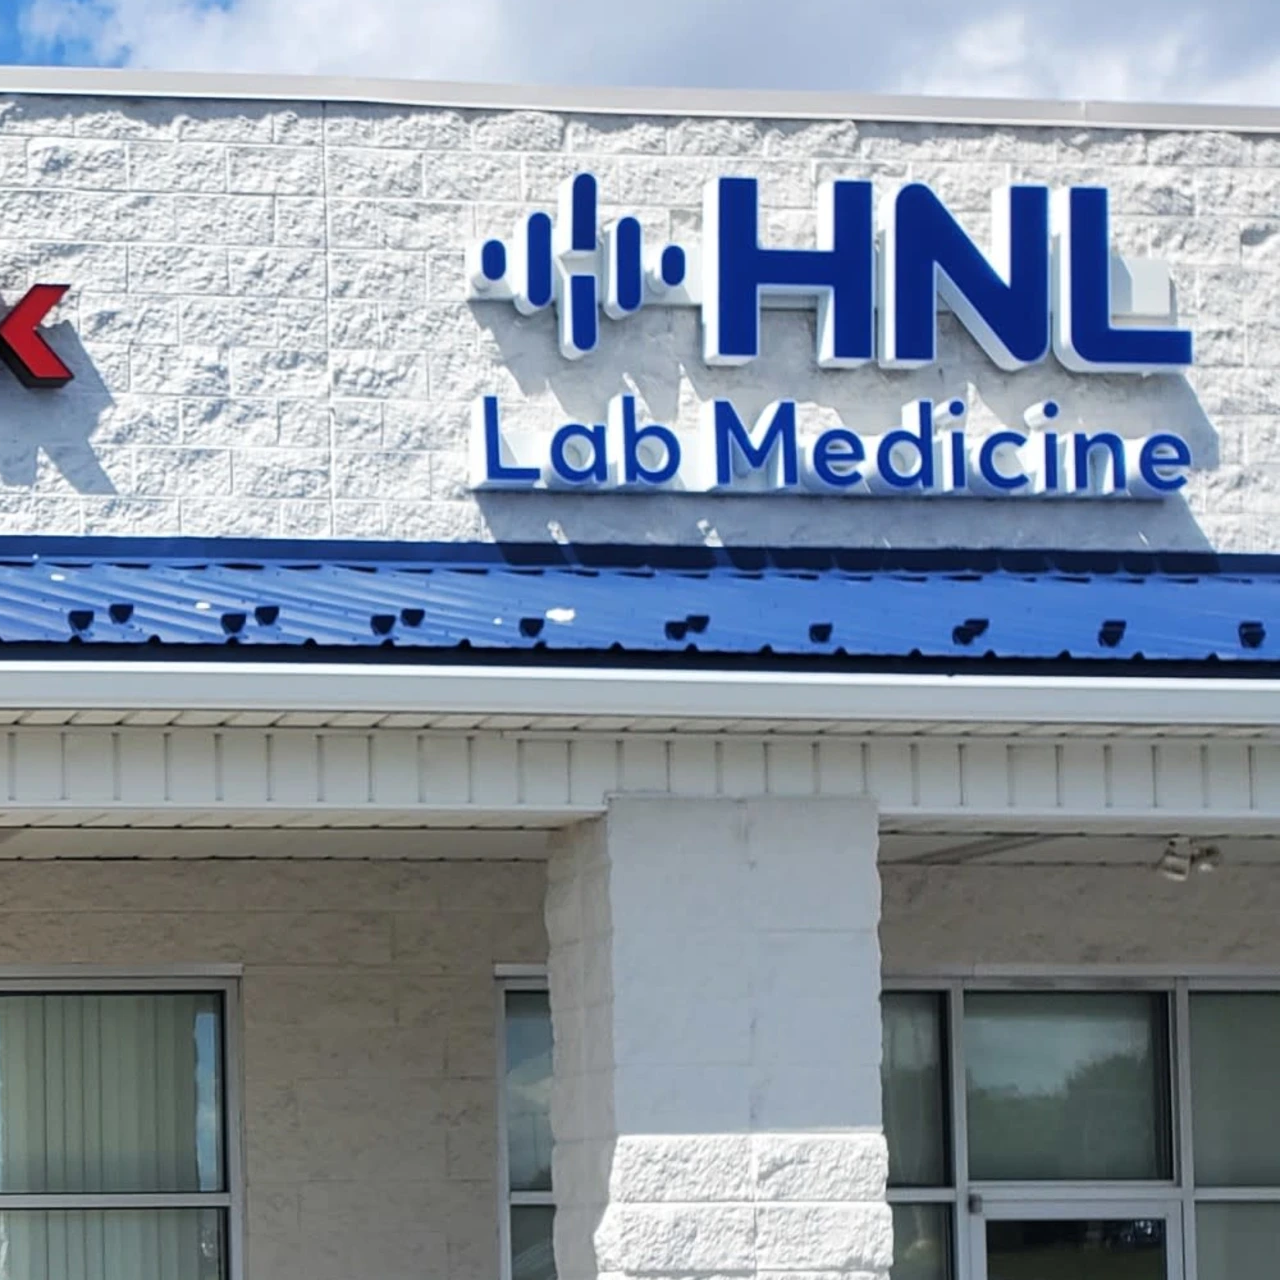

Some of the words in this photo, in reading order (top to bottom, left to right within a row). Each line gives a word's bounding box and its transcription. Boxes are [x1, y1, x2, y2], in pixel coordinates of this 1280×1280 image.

[710, 176, 1194, 370] HNL
[480, 396, 682, 486] Lab
[714, 399, 1192, 492] Medicine
